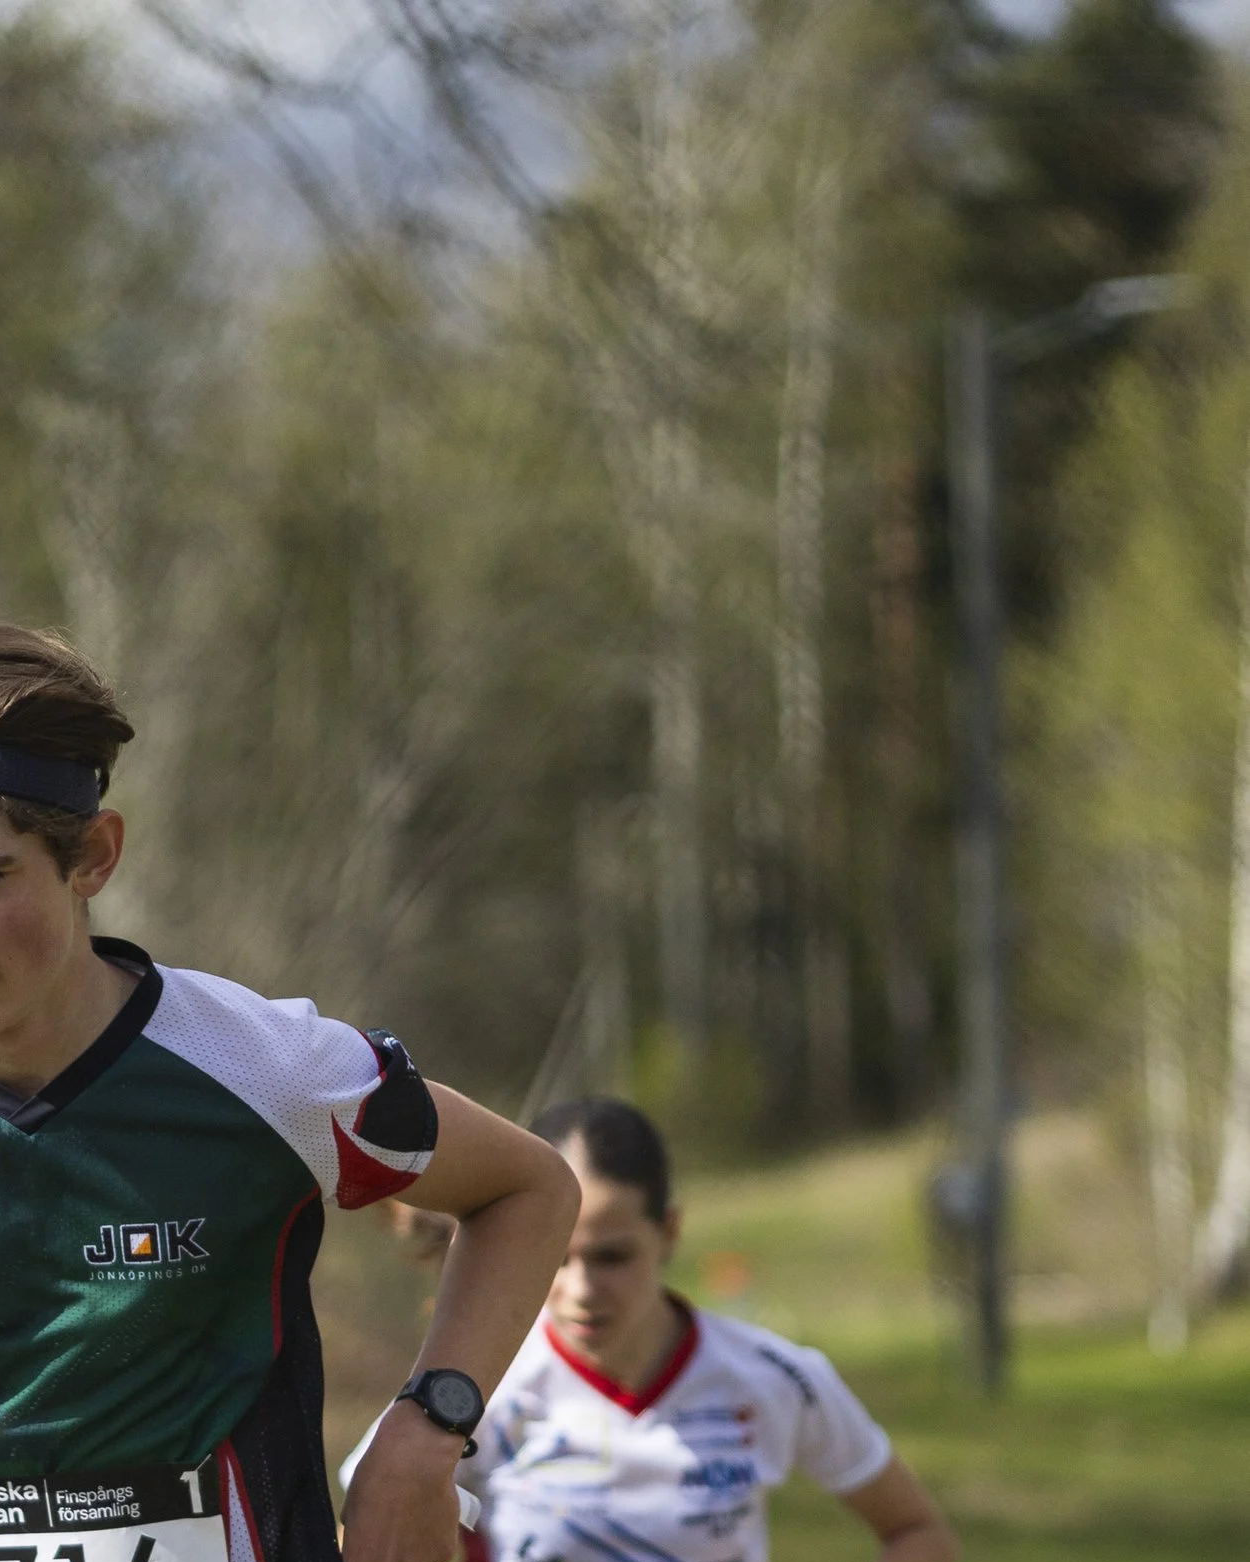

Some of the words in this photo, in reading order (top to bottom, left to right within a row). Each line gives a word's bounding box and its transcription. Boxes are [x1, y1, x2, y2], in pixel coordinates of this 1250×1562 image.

[83, 1217, 210, 1265] JOK
[56, 1486, 134, 1505] Finspångs
[180, 1470, 204, 1514] 1
[57, 1501, 141, 1521] församling
